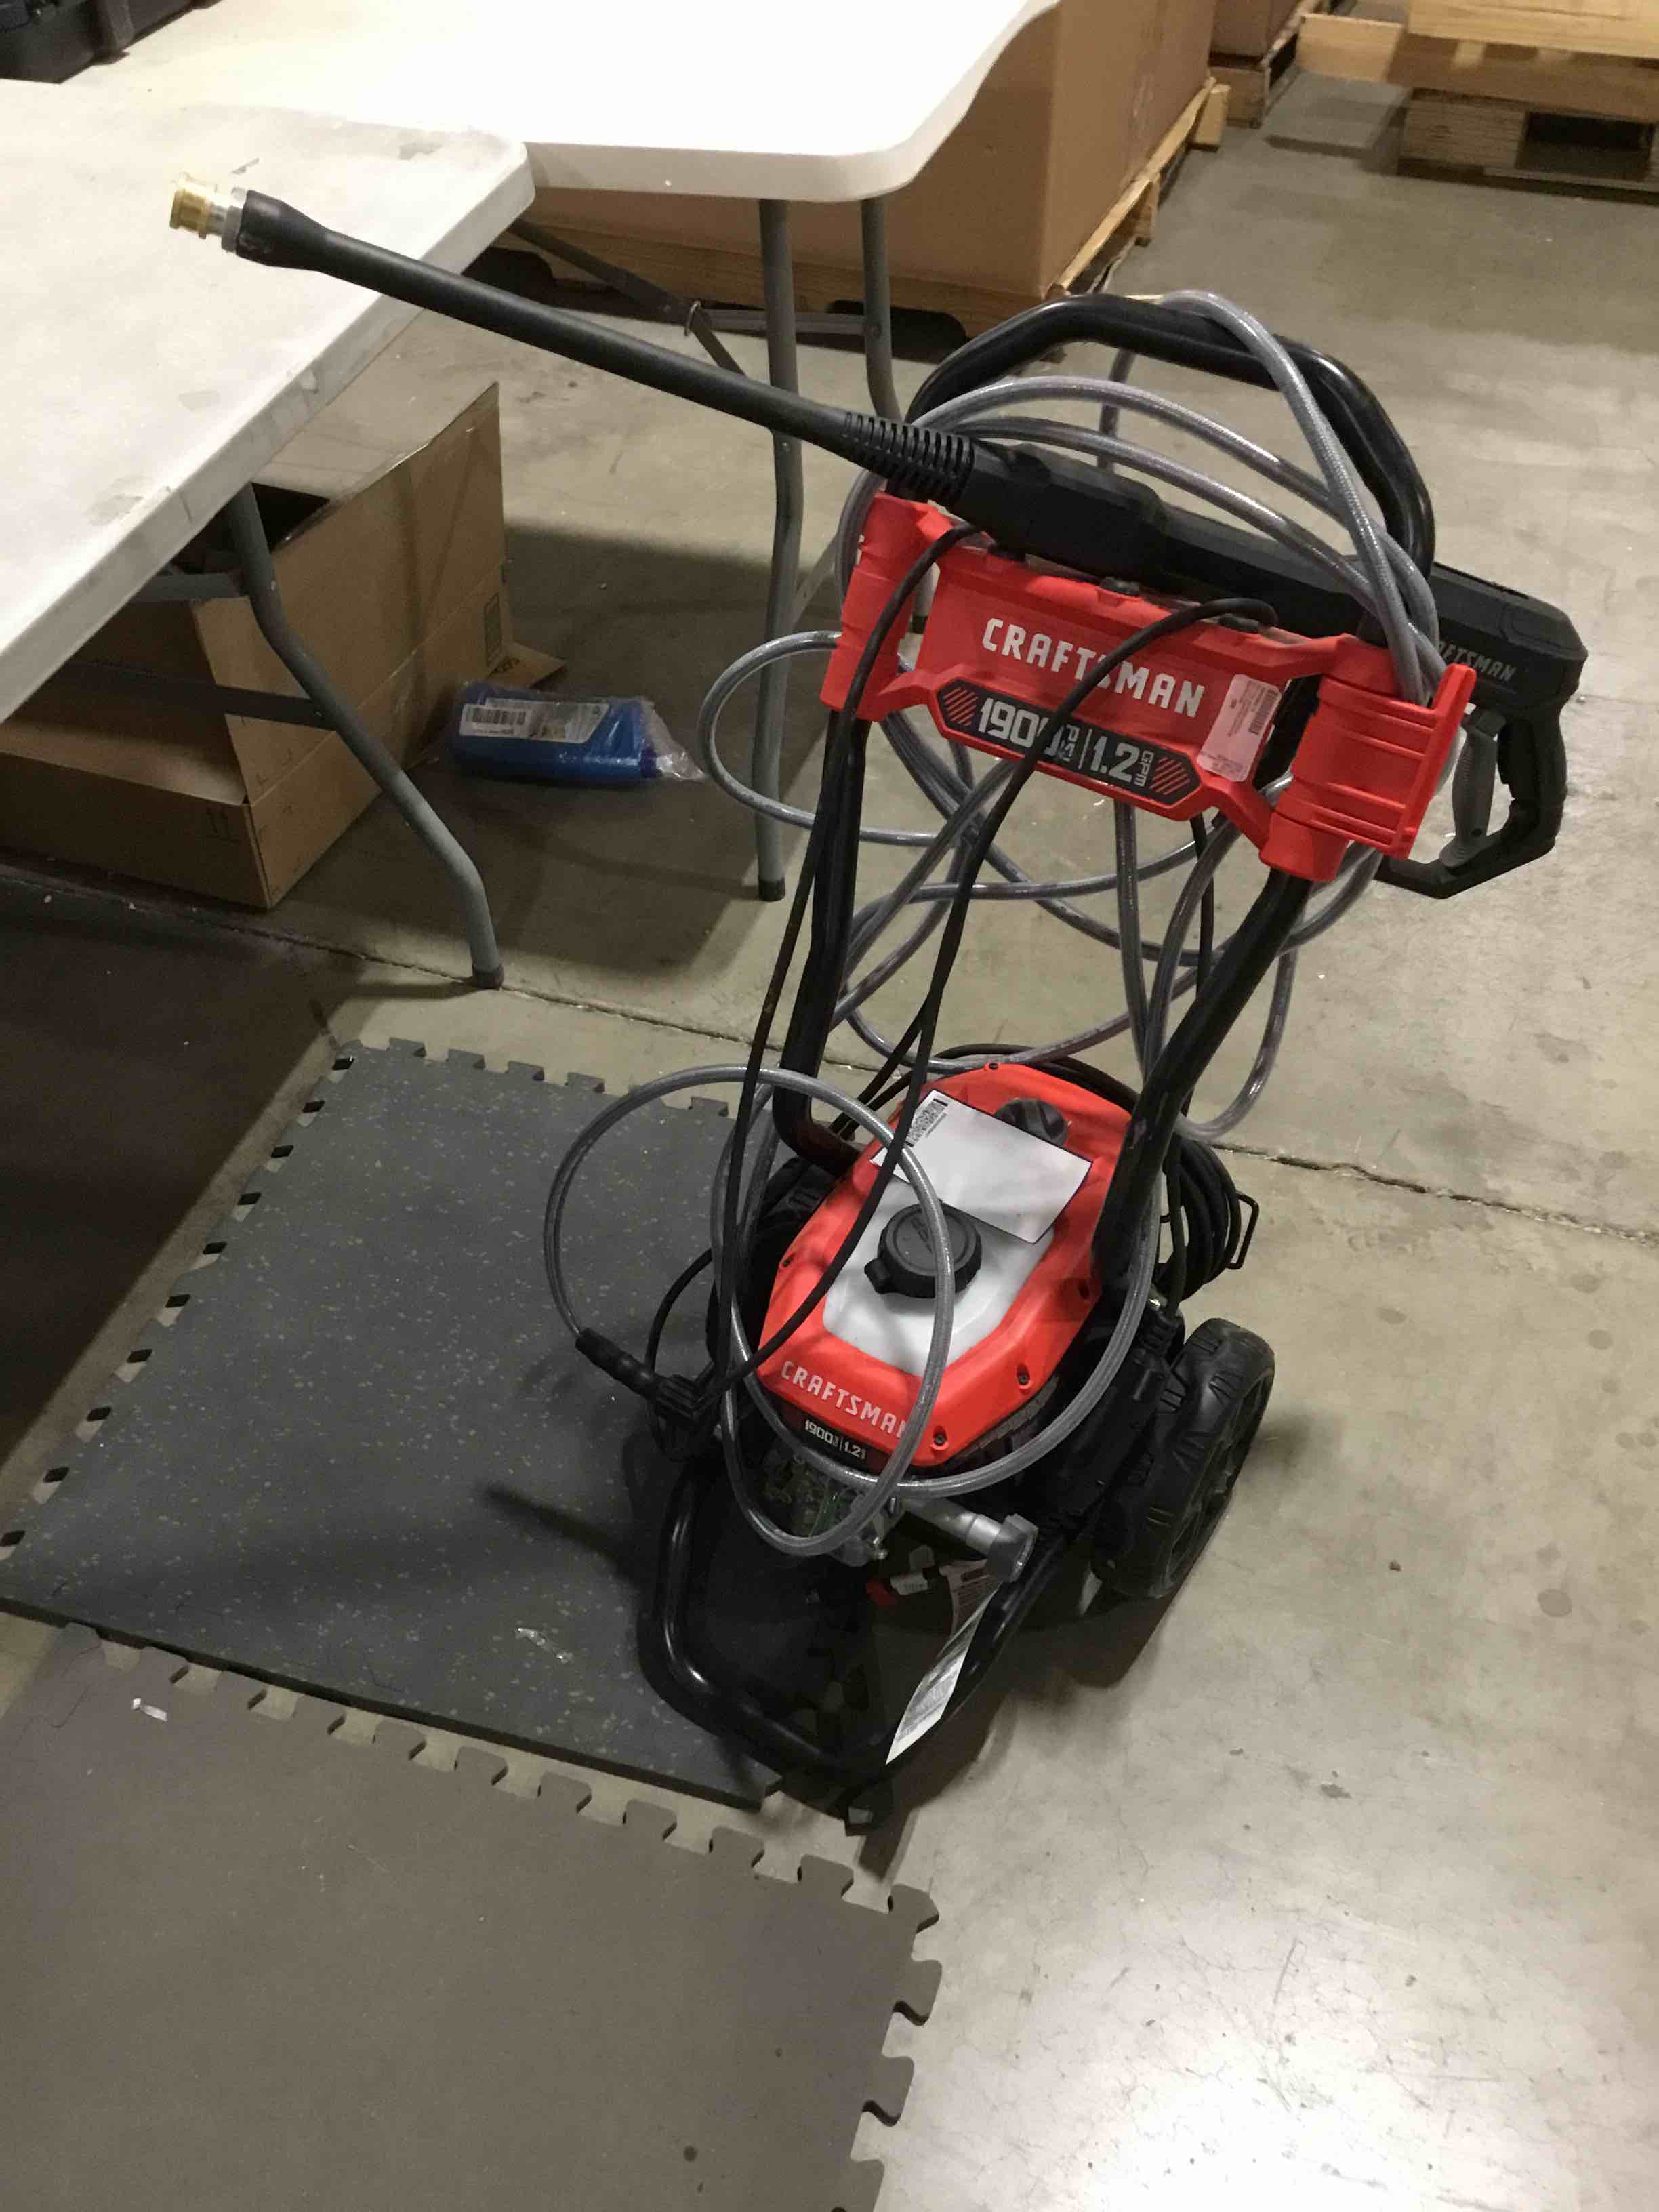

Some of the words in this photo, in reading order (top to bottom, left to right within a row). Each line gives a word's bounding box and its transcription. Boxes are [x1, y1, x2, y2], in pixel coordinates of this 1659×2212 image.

[982, 617, 1204, 718] CRAFTMAN
[1090, 735, 1141, 783] 1.2
[1134, 750, 1155, 787] GPM
[804, 1420, 834, 1445] 1900
